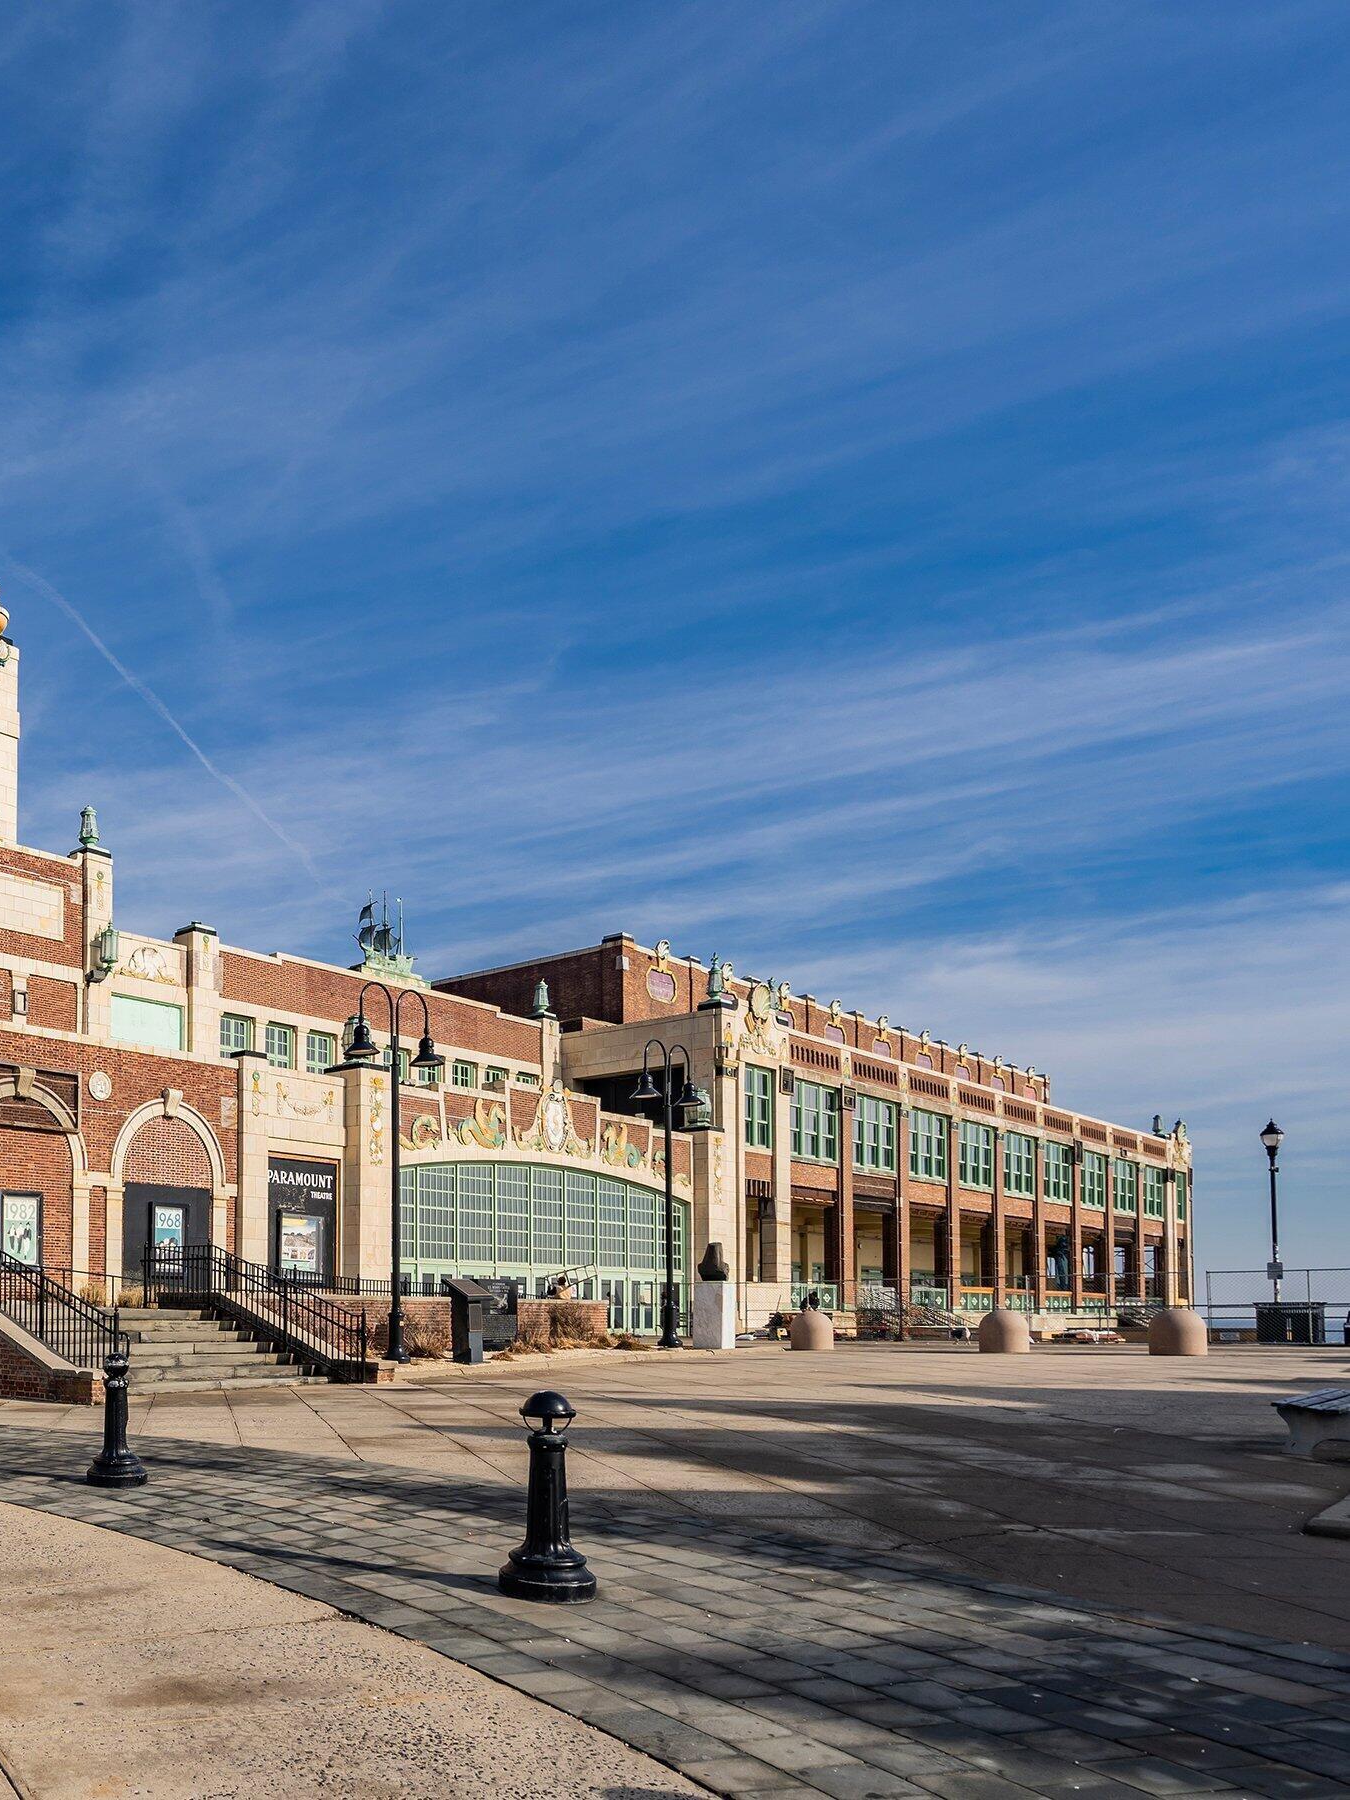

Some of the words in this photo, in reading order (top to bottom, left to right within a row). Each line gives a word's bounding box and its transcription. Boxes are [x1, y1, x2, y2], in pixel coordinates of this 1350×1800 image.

[267, 1169, 333, 1189] PARAMOUNT
[310, 1190, 333, 1201] THEATRE
[4, 1202, 36, 1220] 1982
[155, 1212, 181, 1228] 1968
